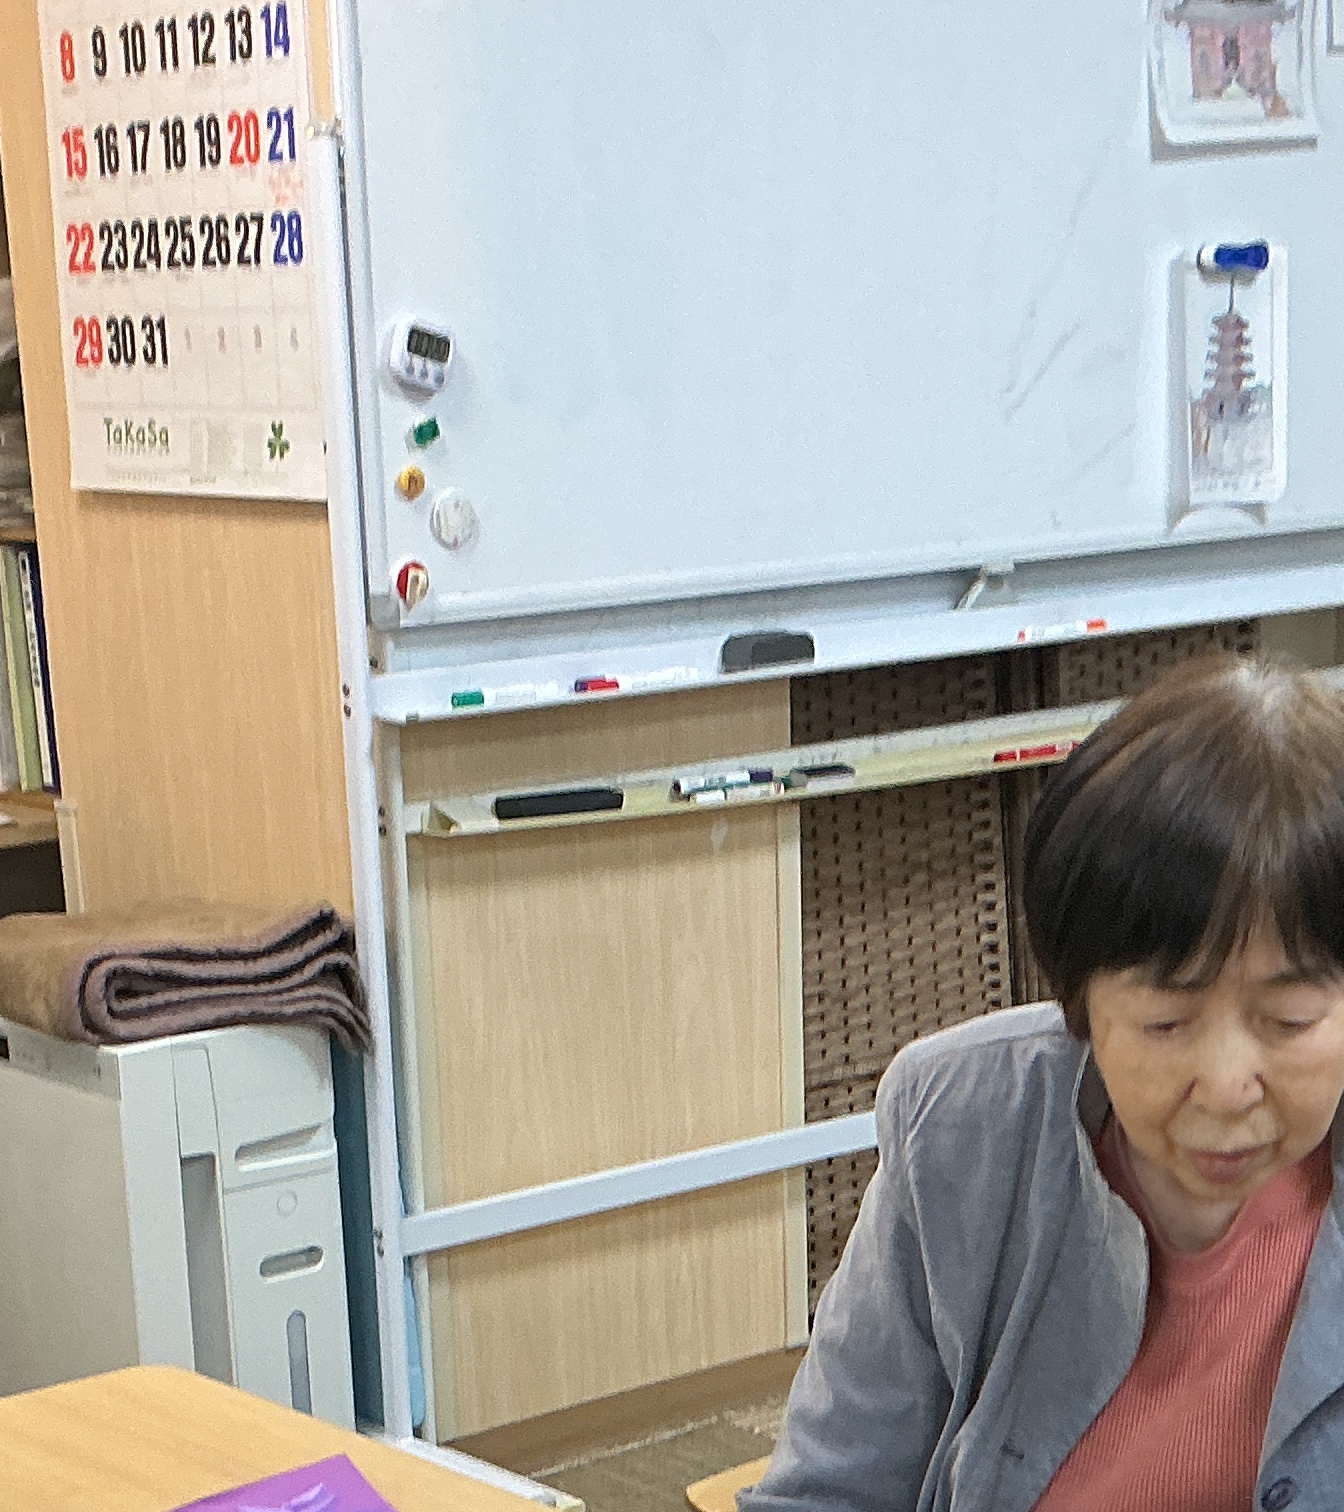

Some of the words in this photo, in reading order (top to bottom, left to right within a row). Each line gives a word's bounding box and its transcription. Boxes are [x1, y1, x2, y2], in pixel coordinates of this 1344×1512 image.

[60, 30, 75, 82] 8
[91, 25, 107, 78] 9
[119, 20, 146, 77] 10
[155, 15, 180, 73] 11
[188, 10, 216, 68] 12
[224, 5, 252, 64] 13
[260, 1, 290, 58] 14
[61, 125, 88, 181] 15
[94, 123, 119, 179] 16
[126, 120, 150, 175] 17
[159, 114, 186, 174] 18
[194, 112, 221, 172] 19
[227, 109, 260, 166] 20
[267, 105, 296, 164] 21
[66, 222, 96, 275] 22
[99, 219, 128, 272] 23
[130, 217, 161, 271] 24
[164, 213, 195, 270] 25
[199, 211, 231, 269] 26
[234, 210, 264, 267] 27
[270, 208, 304, 266] 28
[73, 315, 103, 368] 29
[106, 313, 136, 367] 30
[141, 312, 169, 368] 31
